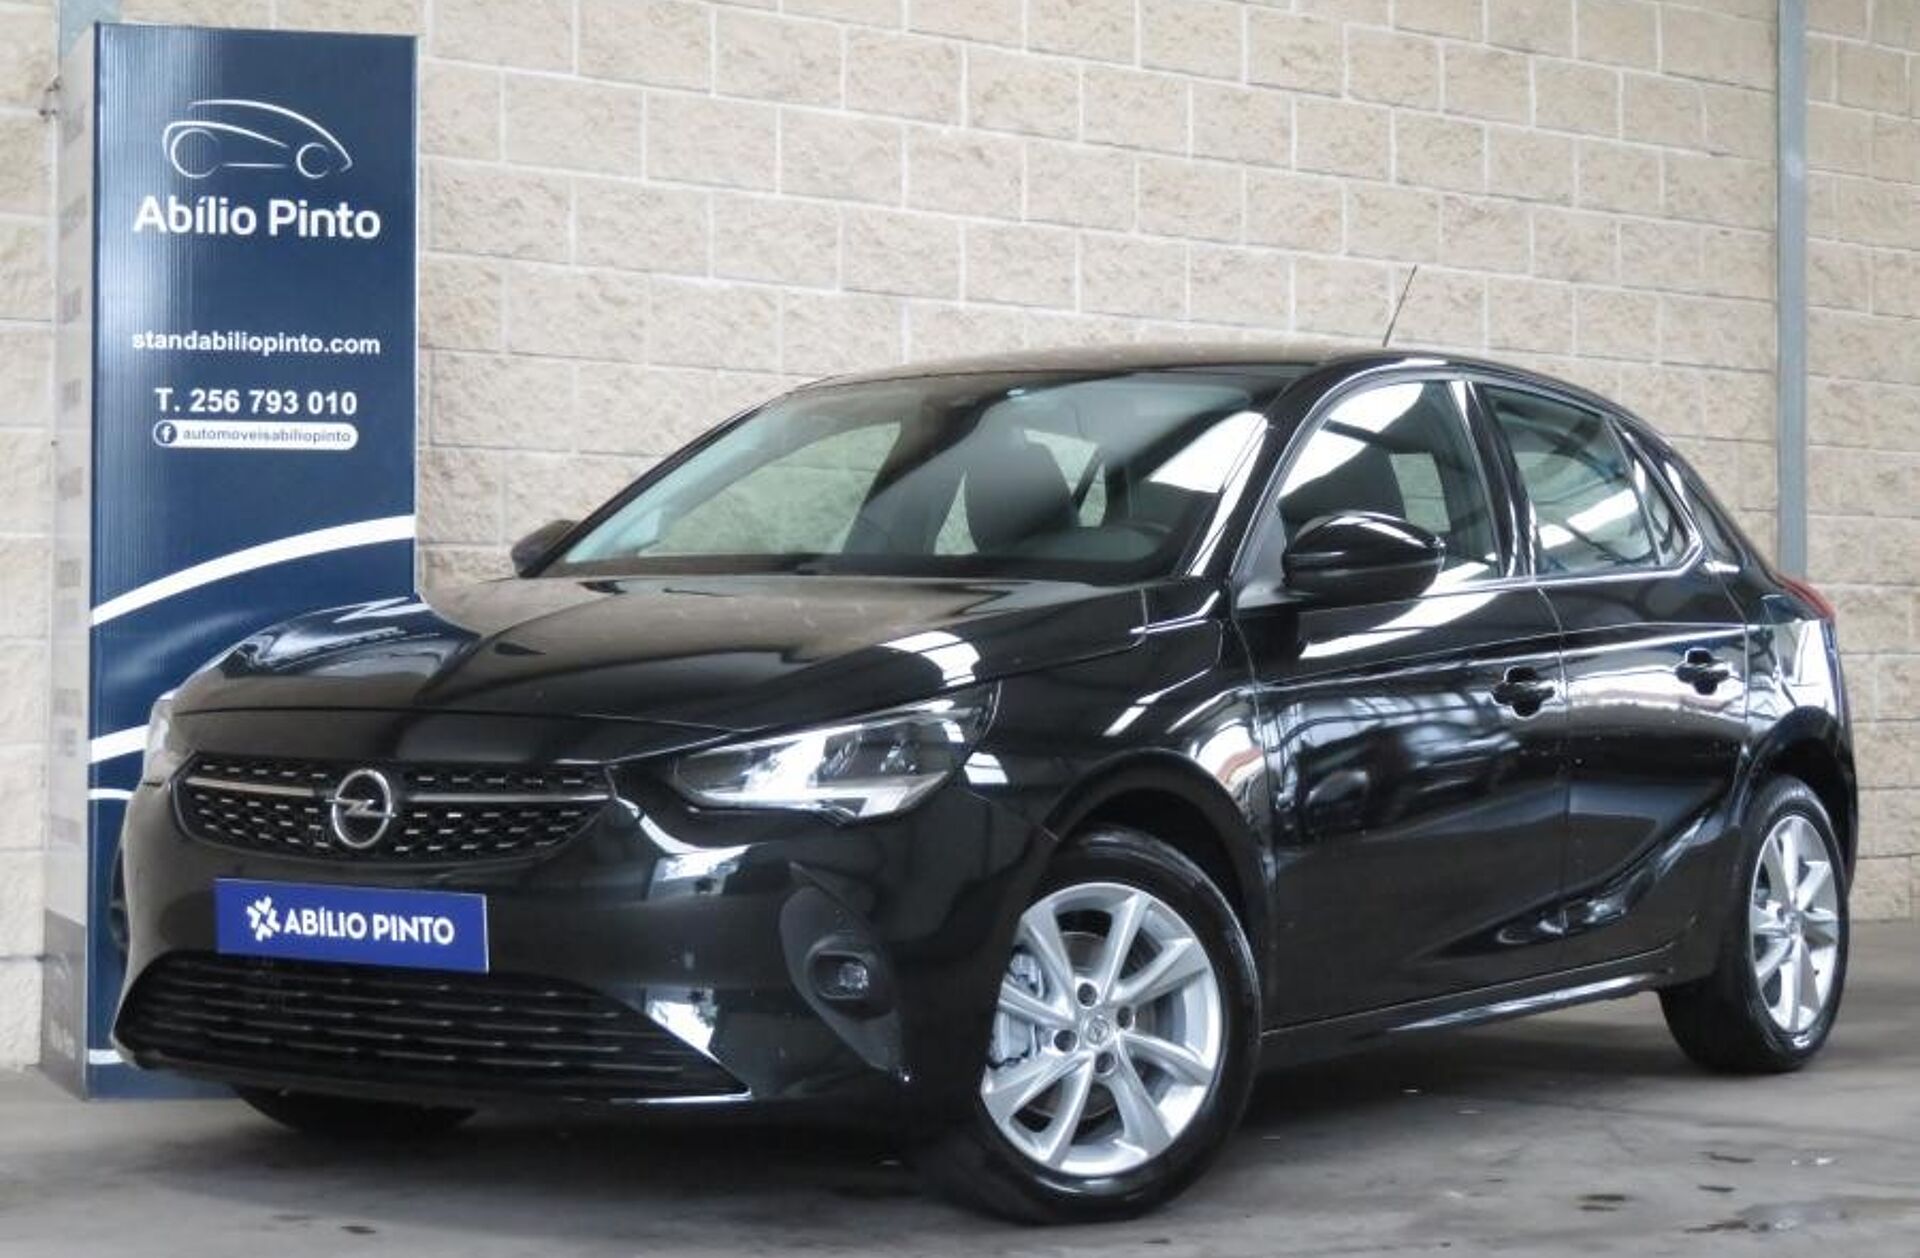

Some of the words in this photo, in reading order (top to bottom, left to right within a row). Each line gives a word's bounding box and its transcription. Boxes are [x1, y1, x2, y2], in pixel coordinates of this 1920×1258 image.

[133, 195, 257, 235] Abílio
[268, 199, 381, 239] Pinto
[132, 330, 381, 357] standabiliopinto.com
[154, 387, 181, 413] T.
[189, 388, 241, 413] 256
[248, 390, 299, 415] 793
[307, 391, 358, 415] 010
[182, 428, 352, 444] automoveisabiliopinto
[283, 906, 367, 940] ABÍLIO
[372, 913, 455, 945] PINTO
